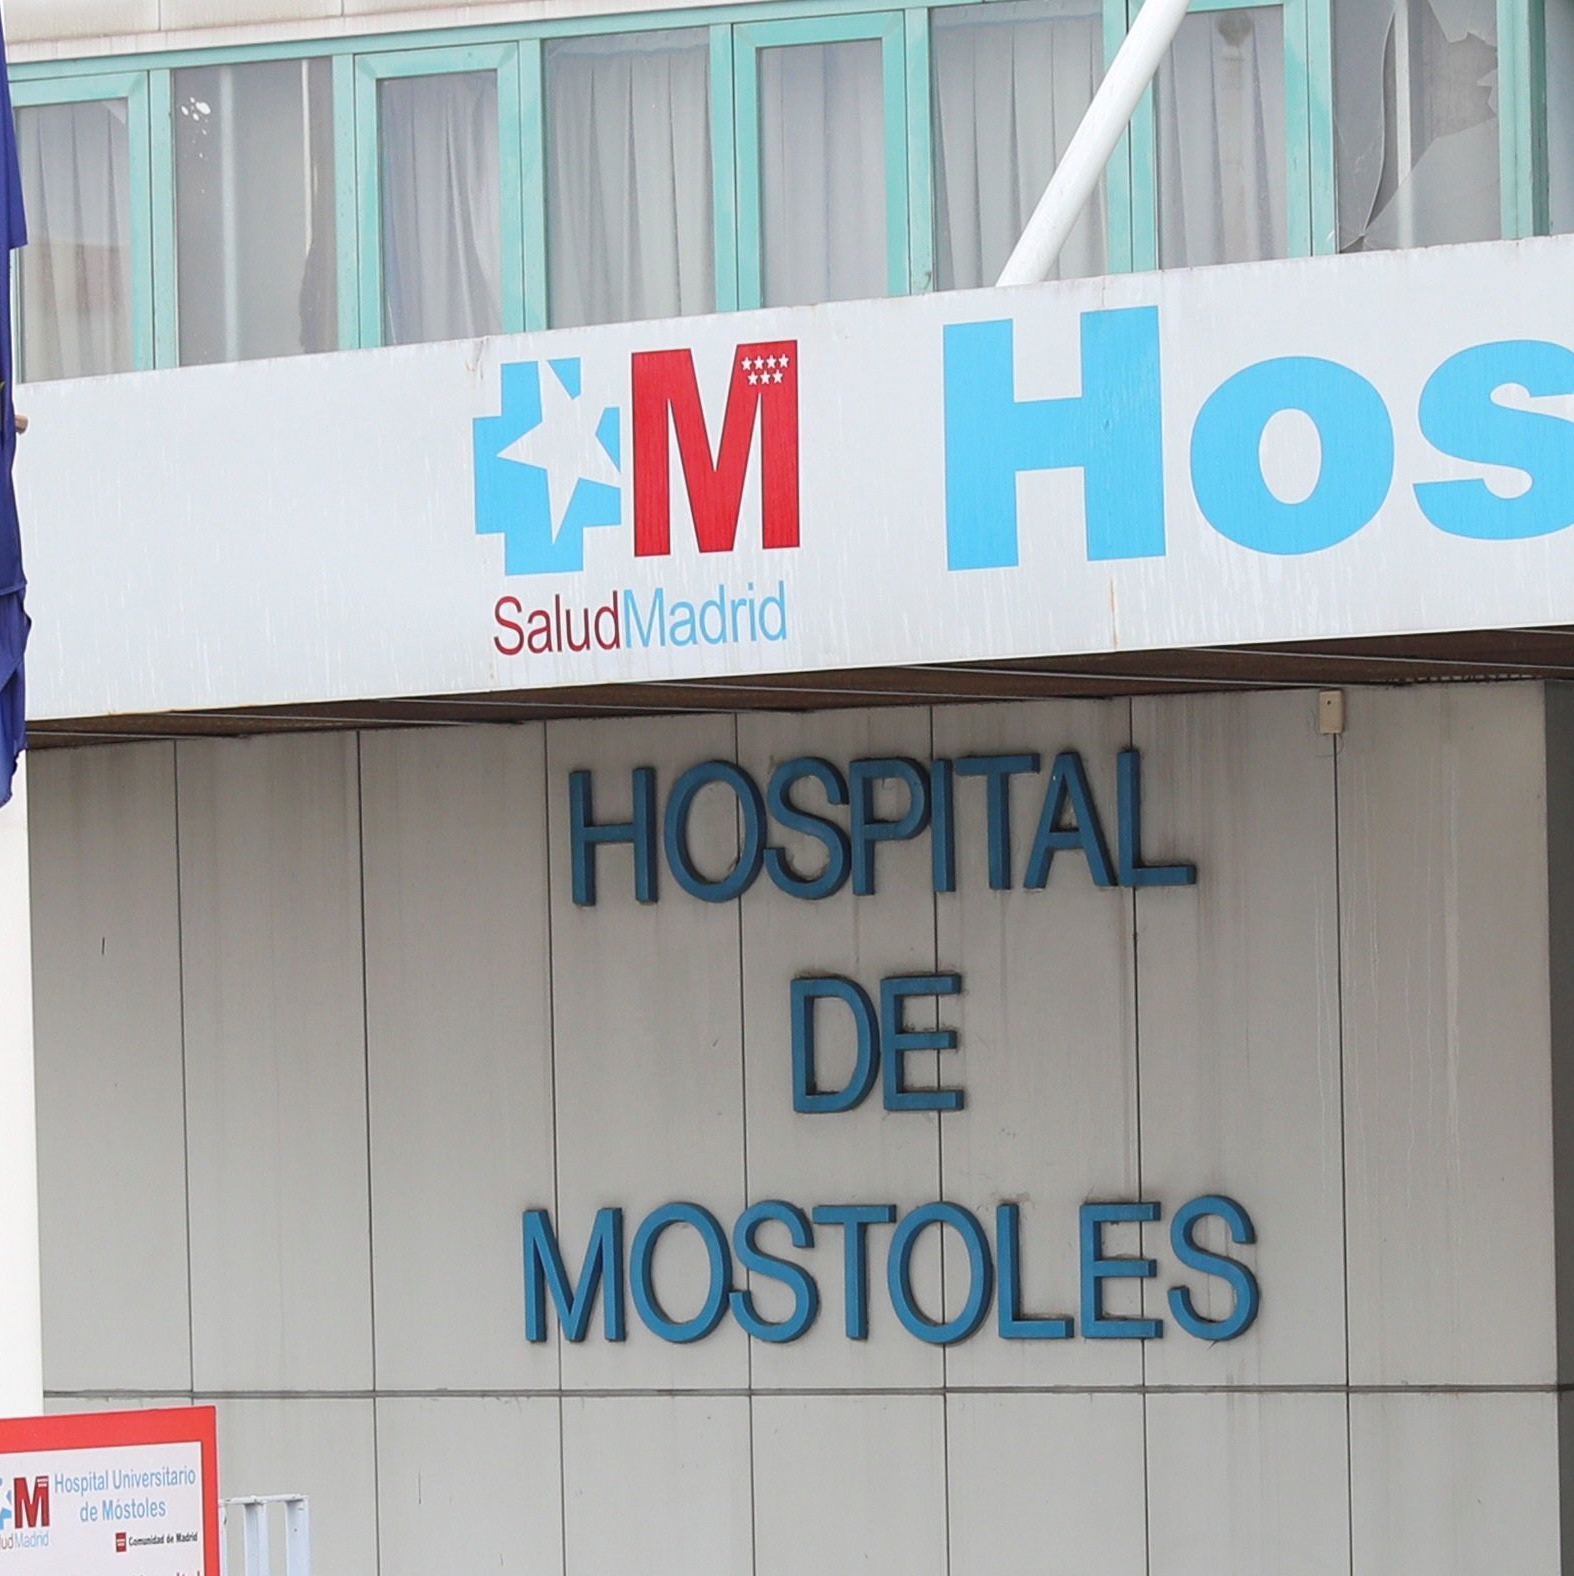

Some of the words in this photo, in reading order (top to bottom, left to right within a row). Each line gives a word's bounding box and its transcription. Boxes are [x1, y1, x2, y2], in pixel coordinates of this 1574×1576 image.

[493, 580, 788, 656] SaludMadrid
[569, 748, 1197, 906] HOSPITAL
[790, 972, 965, 1114] DE
[522, 1194, 1260, 1345] MOSTOLES
[54, 1469, 109, 1496] Hospital
[112, 1465, 196, 1490] Universitario
[79, 1501, 98, 1522] de
[102, 1497, 166, 1521] Móstoles
[128, 1534, 165, 1547] Comunidad
[166, 1535, 175, 1545] de
[176, 1531, 198, 1543] Madrid
